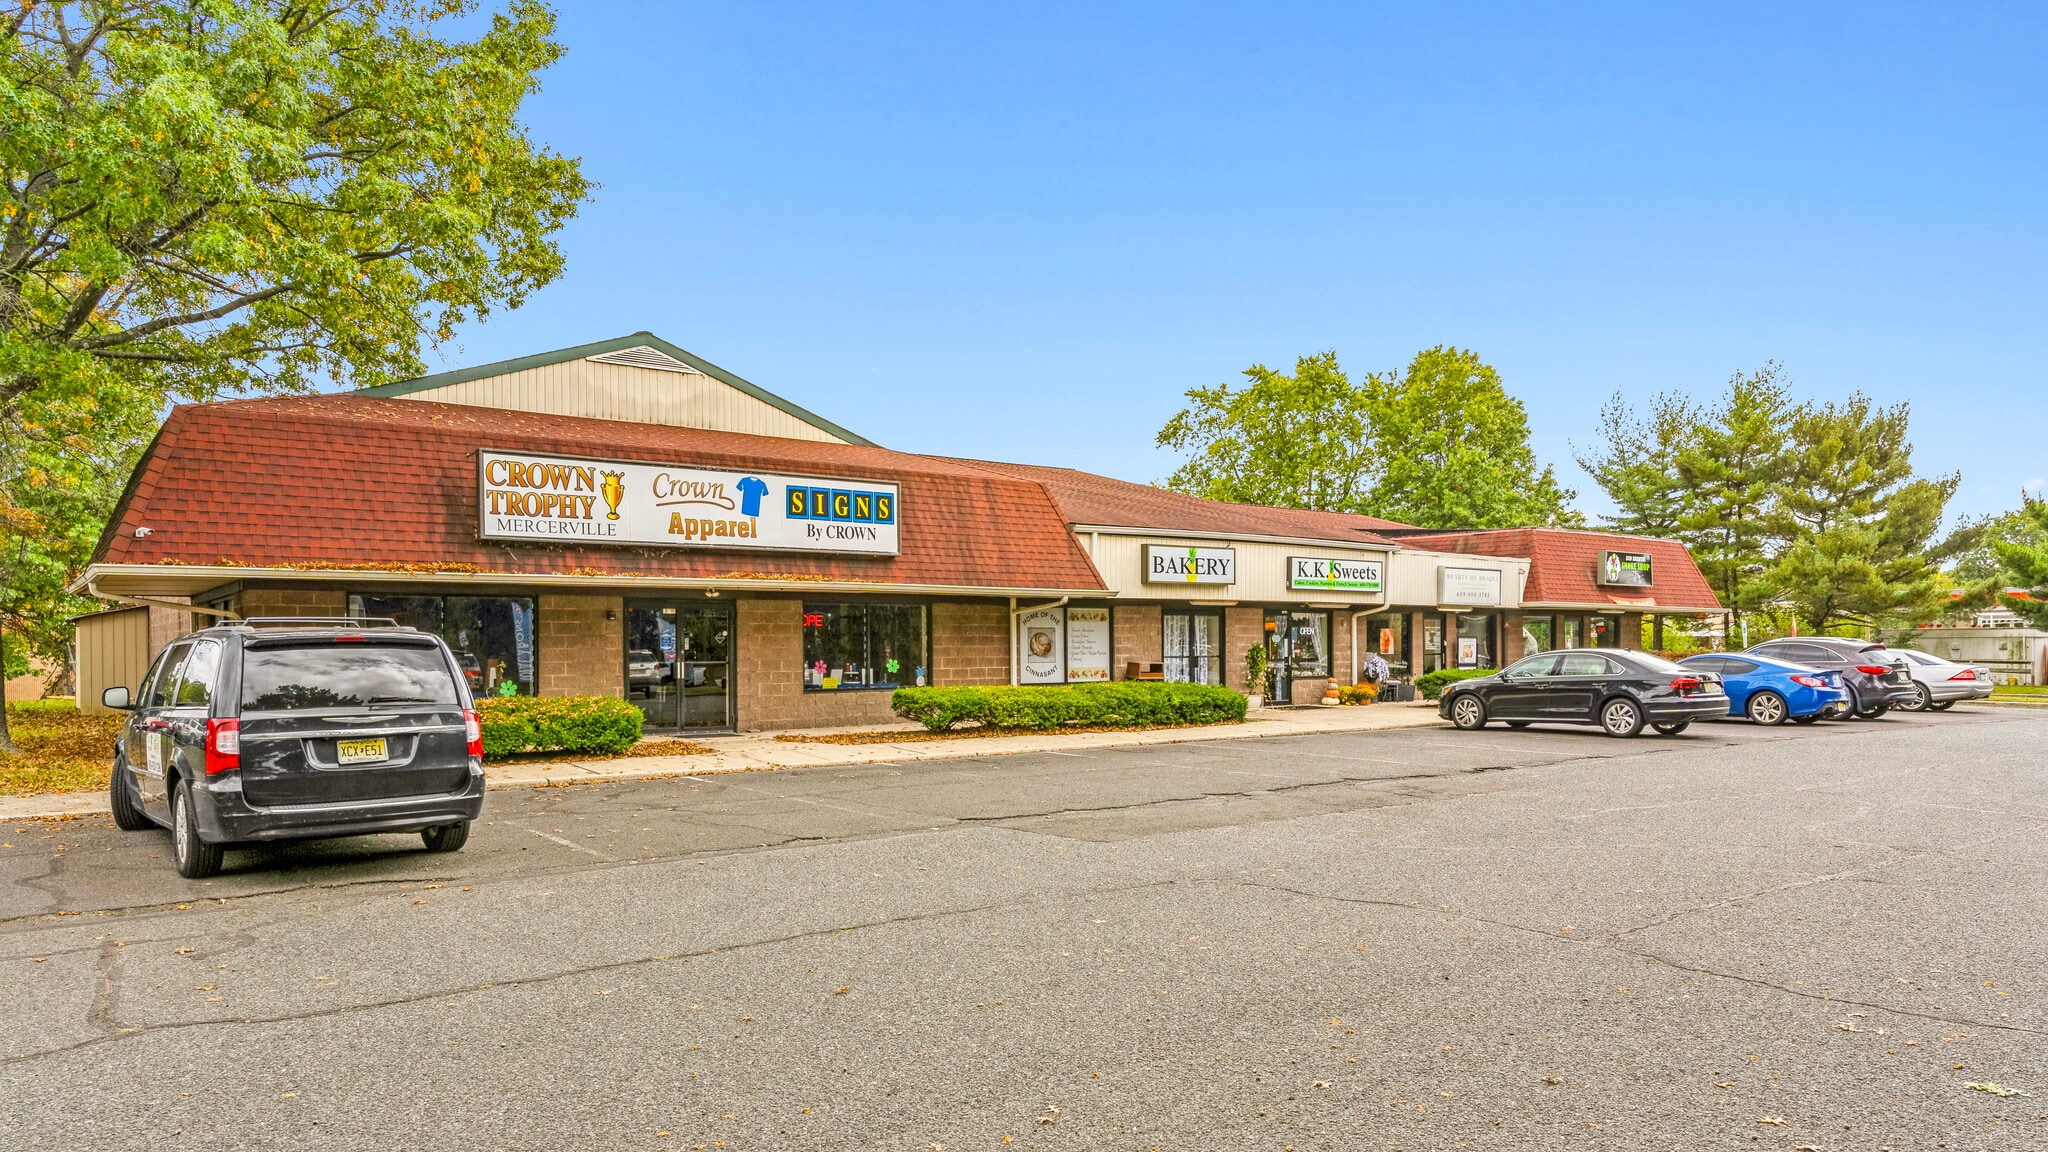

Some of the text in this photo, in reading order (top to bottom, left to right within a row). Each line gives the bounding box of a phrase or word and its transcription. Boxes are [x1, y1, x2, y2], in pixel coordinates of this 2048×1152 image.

[485, 459, 596, 493] CROWN
[652, 472, 735, 511] Crown
[485, 489, 597, 520] TROPHY
[791, 491, 889, 519] SIGNS
[496, 518, 617, 537] MERCERVILLE
[668, 512, 757, 541] Apparel
[806, 523, 876, 541] By CROWN
[1152, 555, 1231, 576] BAKERY
[1297, 560, 1377, 581] K.K. Sweets
[1022, 611, 1039, 625] HOME
[1050, 614, 1061, 626] THE
[1300, 627, 1314, 635] OPEN
[1025, 664, 1058, 678] CINNASANT
